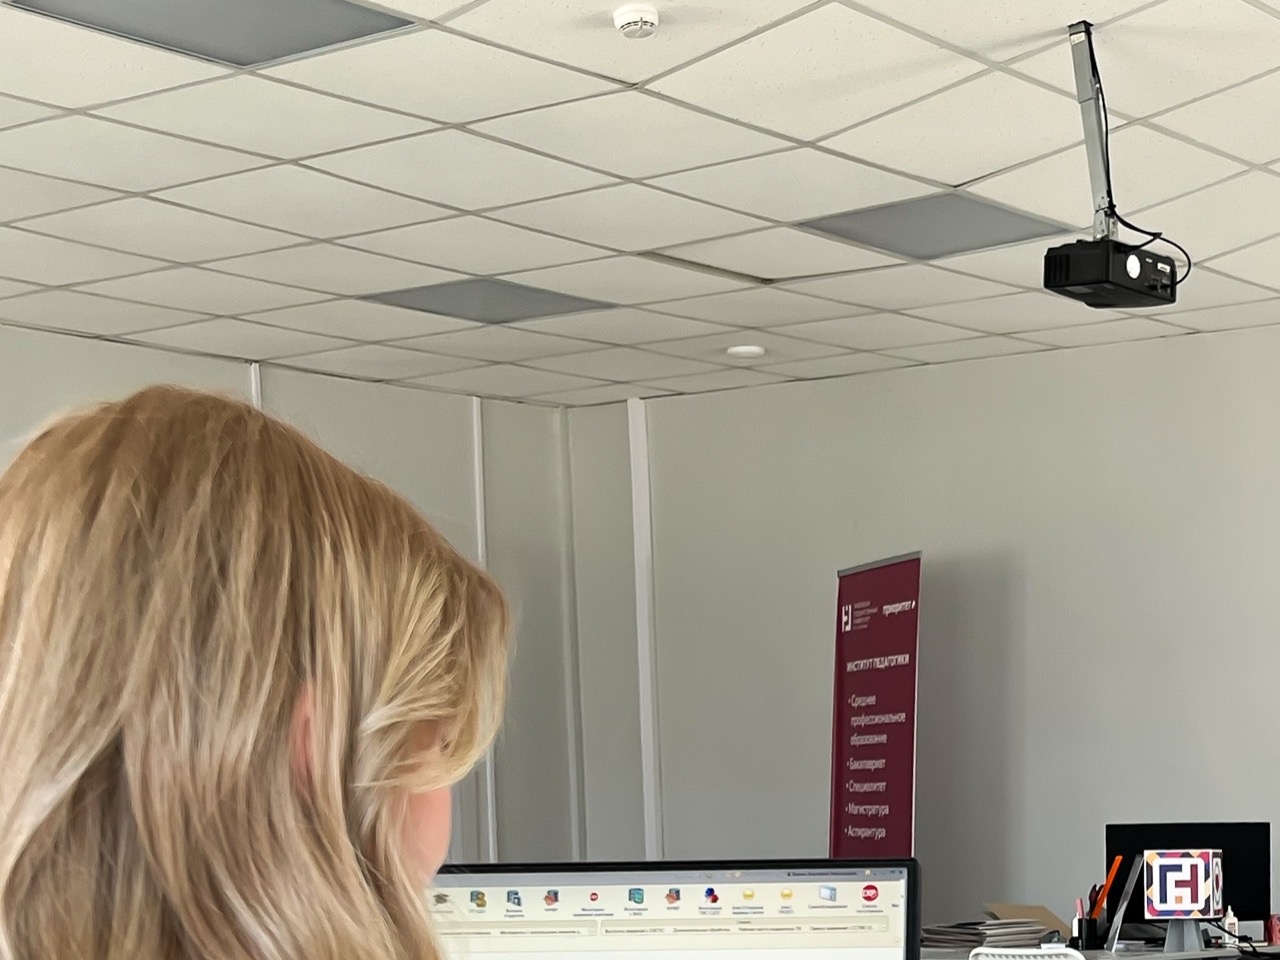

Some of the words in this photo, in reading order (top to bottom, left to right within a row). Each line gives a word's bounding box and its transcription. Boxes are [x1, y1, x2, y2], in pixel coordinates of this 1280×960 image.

[846, 657, 873, 673] ИНСТИТУТ
[873, 653, 910, 670] ПЕДАГОГИКИ
[850, 711, 906, 728] профессиональное
[850, 733, 888, 747] образование
[848, 802, 890, 817] Магистратура
[847, 825, 886, 840] Аспирантура
